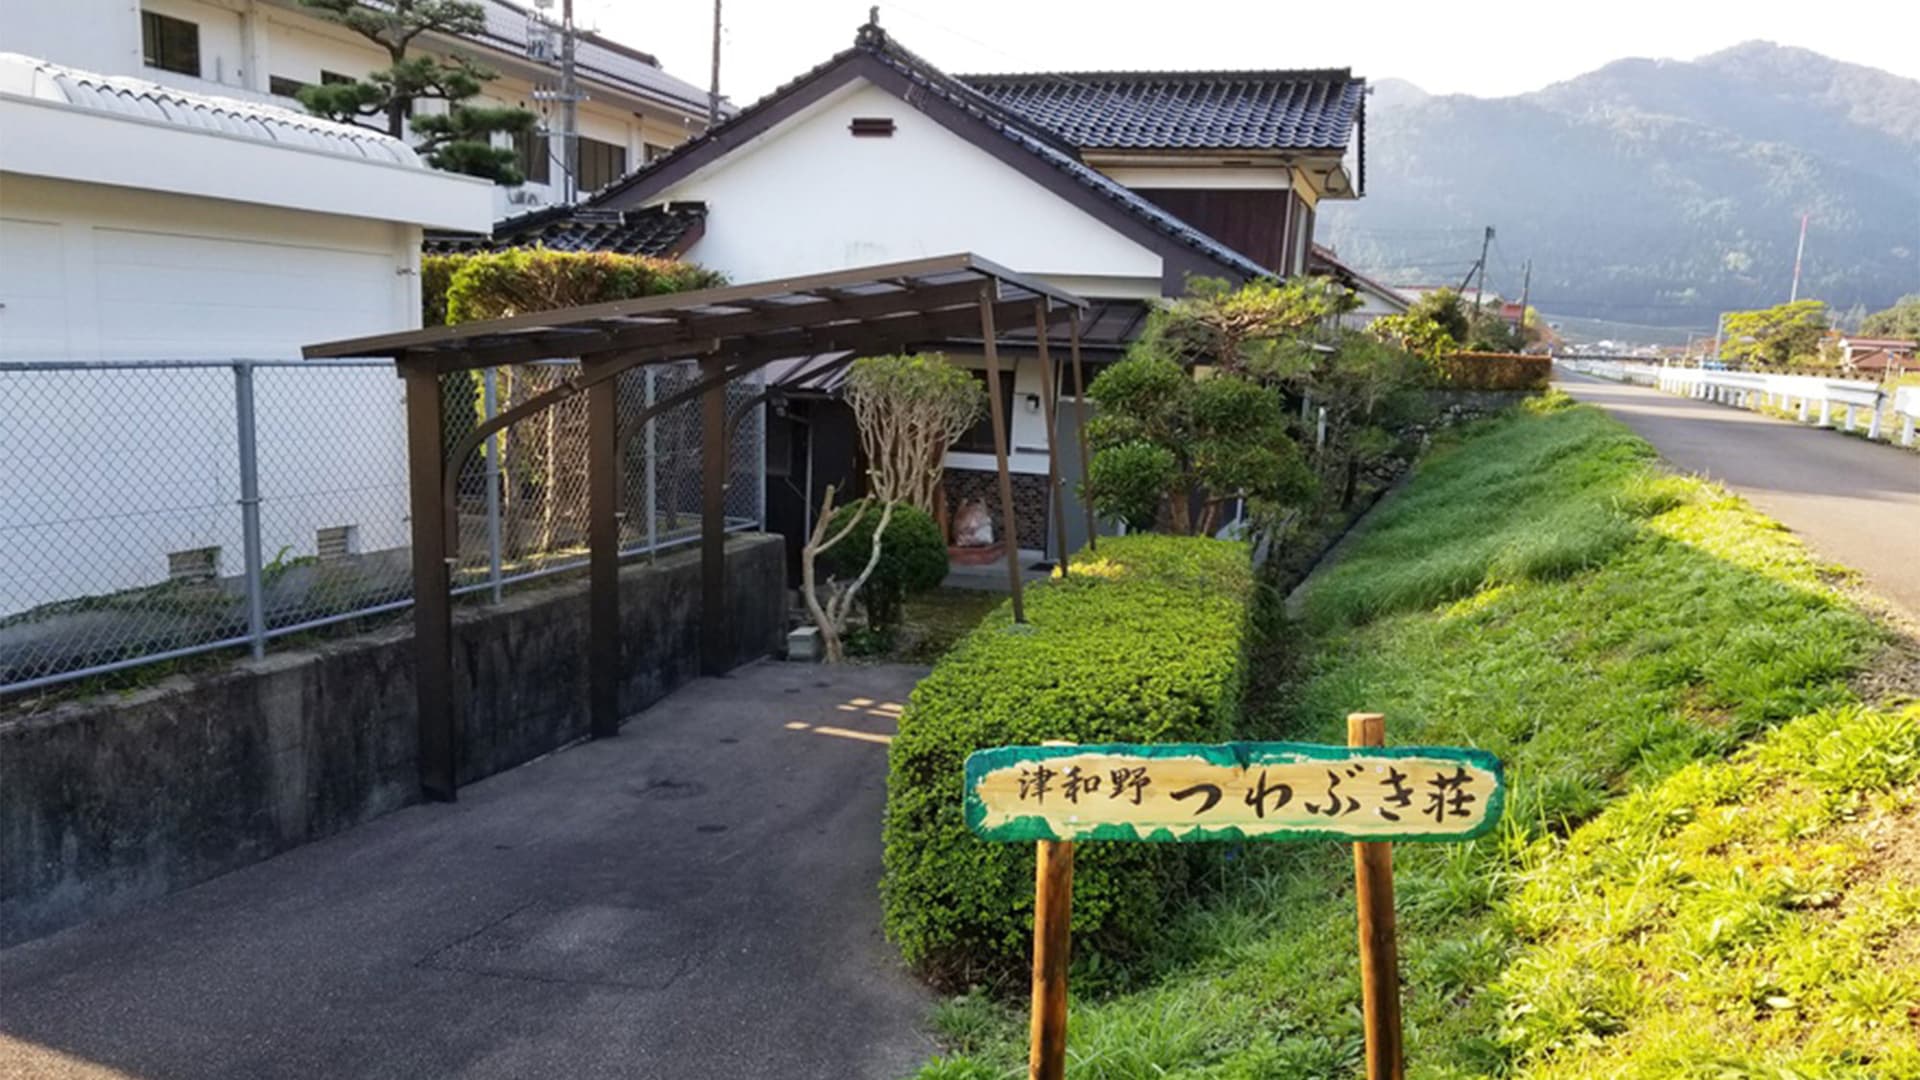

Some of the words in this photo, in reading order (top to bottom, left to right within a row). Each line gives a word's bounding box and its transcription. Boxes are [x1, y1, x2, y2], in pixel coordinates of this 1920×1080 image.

[1017, 765, 1152, 806] 津和野
[1169, 764, 1477, 823] つわぶき荘
